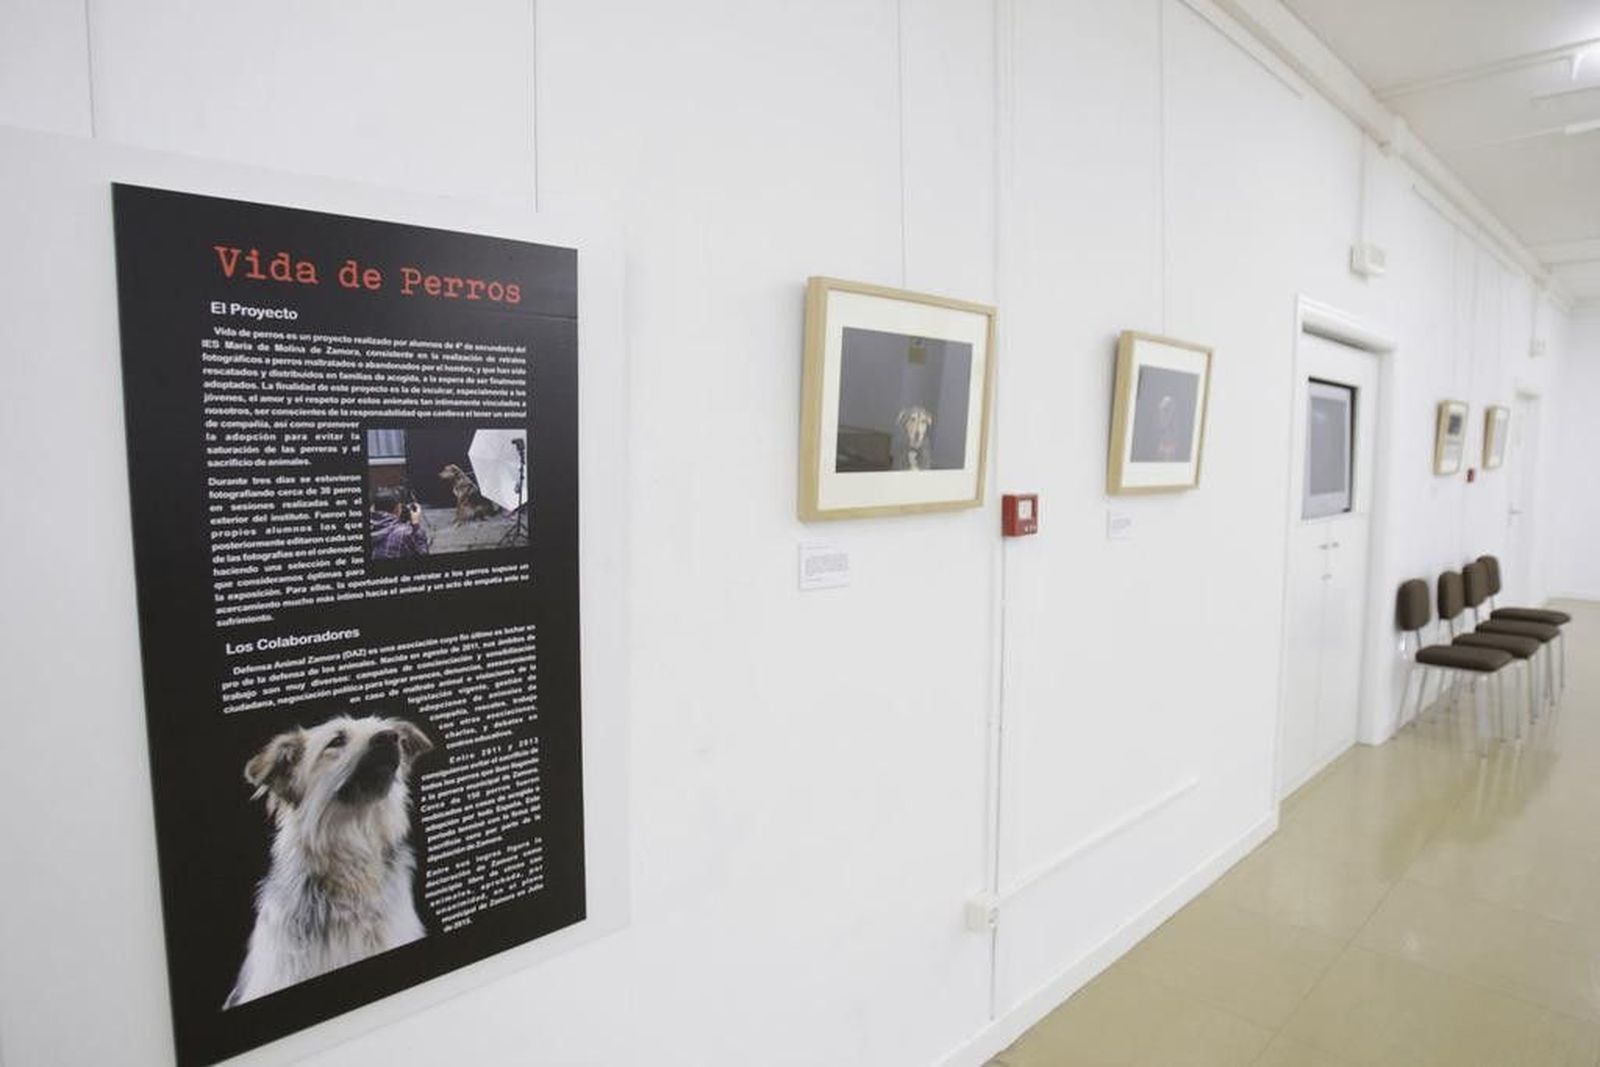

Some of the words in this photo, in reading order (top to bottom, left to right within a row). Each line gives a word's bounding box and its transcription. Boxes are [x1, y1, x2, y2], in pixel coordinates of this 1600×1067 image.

[215, 245, 320, 284] Vida
[336, 260, 382, 291] de
[400, 266, 521, 304] Perros
[211, 302, 226, 314] El
[230, 303, 298, 320] Proyecto
[226, 642, 258, 655] Los
[261, 629, 361, 651] Colaboradores
